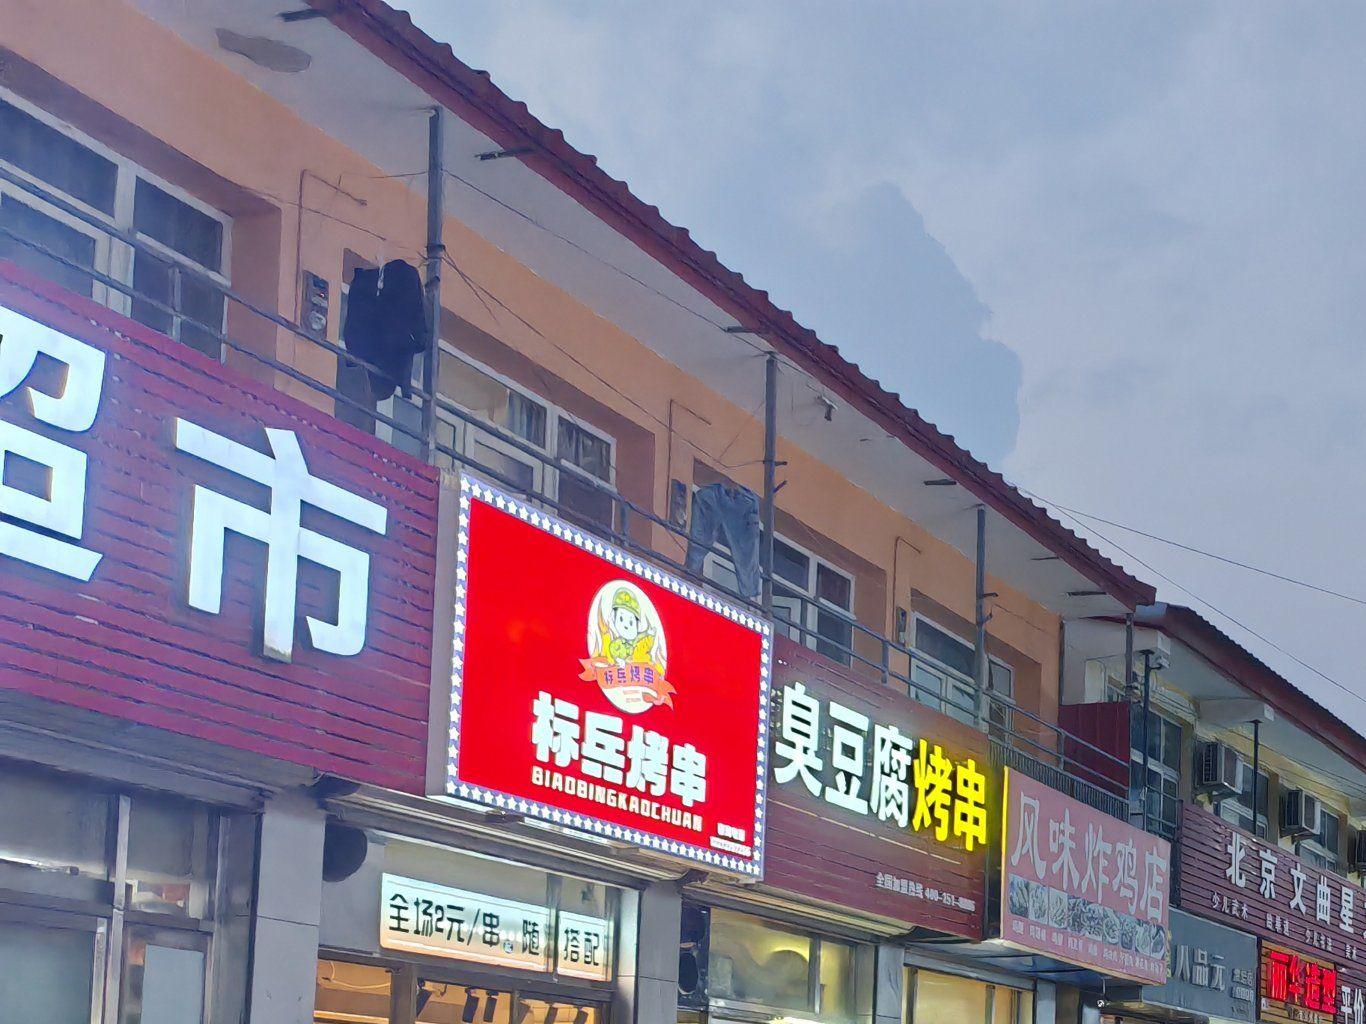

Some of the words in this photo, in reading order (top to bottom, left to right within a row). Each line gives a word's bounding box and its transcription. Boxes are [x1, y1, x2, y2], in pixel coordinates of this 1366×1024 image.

[531, 689, 708, 808] 标兵烤串
[531, 765, 704, 833] BIAOBINGKAOCHUAN
[773, 681, 988, 853] 臭豆腐烤串
[1010, 791, 1169, 924] 风味炸鸡店
